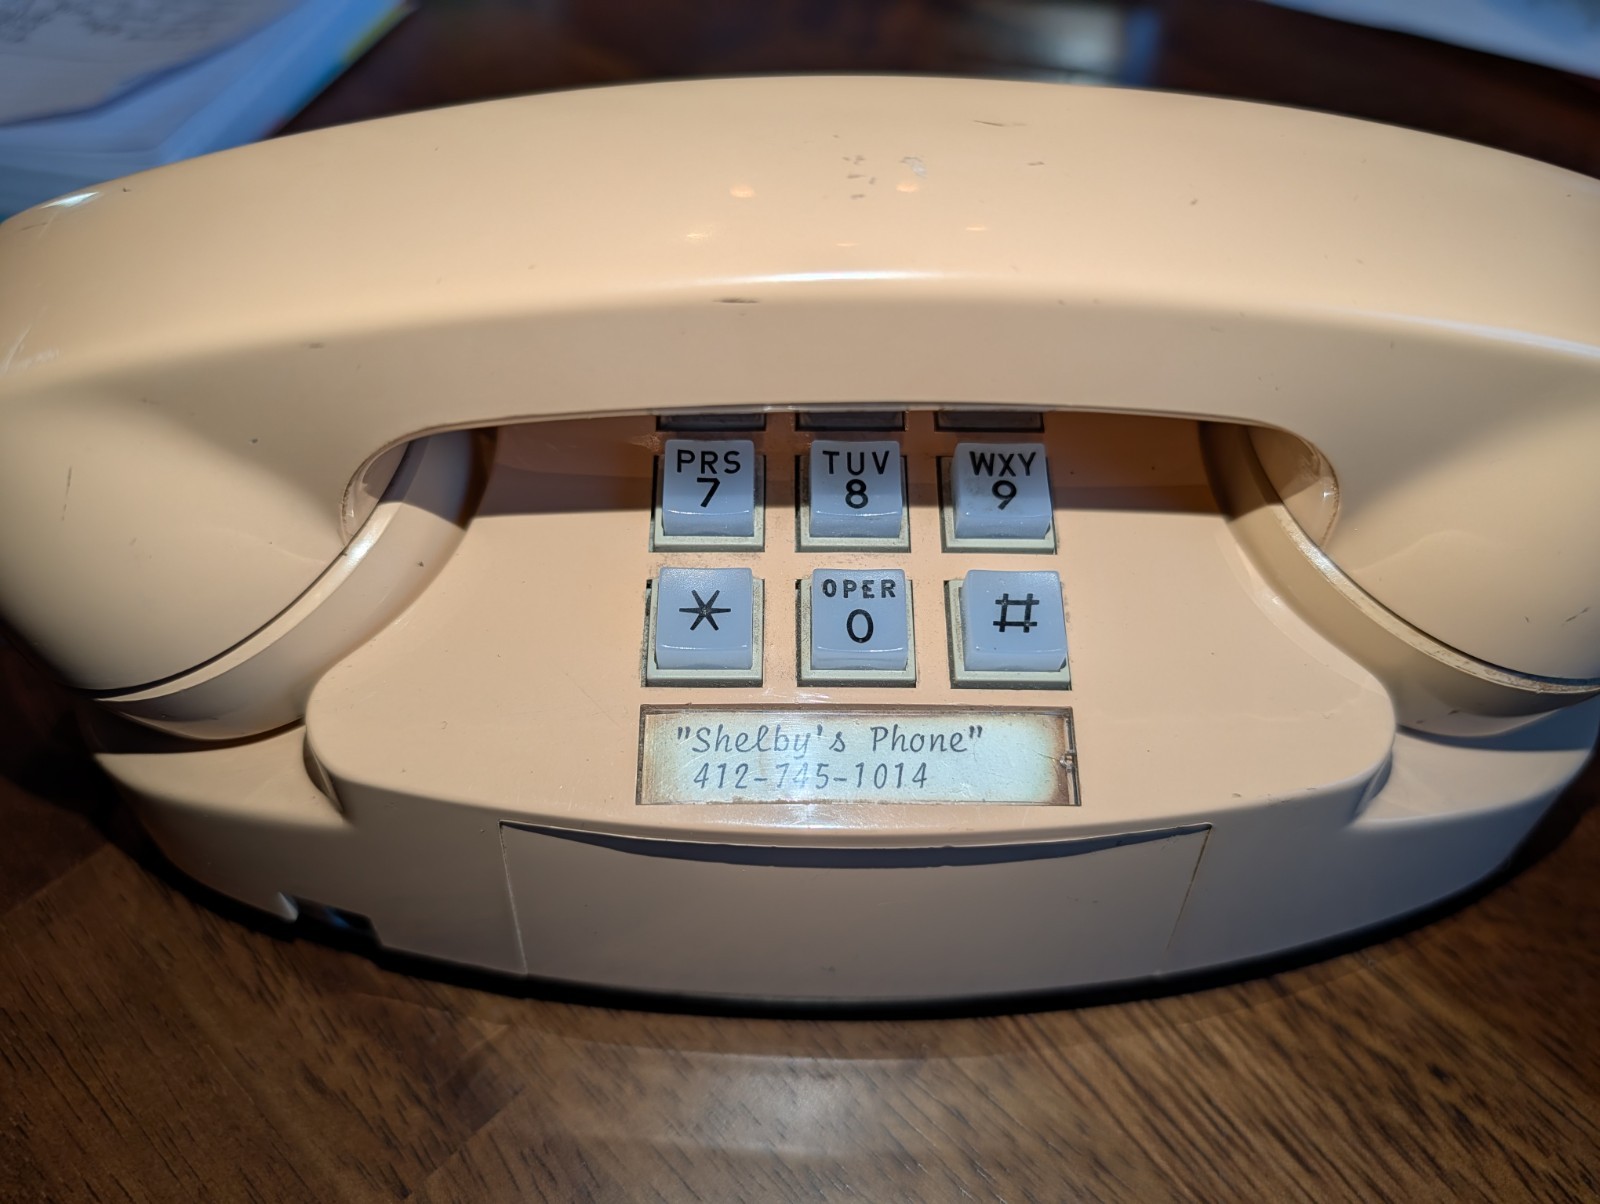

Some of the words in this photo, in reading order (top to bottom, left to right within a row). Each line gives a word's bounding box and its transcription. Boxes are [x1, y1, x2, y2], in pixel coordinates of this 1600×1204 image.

[676, 449, 741, 474] PRS
[822, 450, 890, 475] TUV
[969, 451, 1037, 477] WXY
[696, 477, 720, 508] 7
[845, 479, 869, 509] 8
[992, 480, 1017, 510] 9
[822, 579, 896, 599] OPER
[846, 609, 874, 643] 0
[677, 724, 846, 759] "Shelby's
[870, 724, 983, 752] Phone"
[693, 762, 927, 789] 412-745-1014
